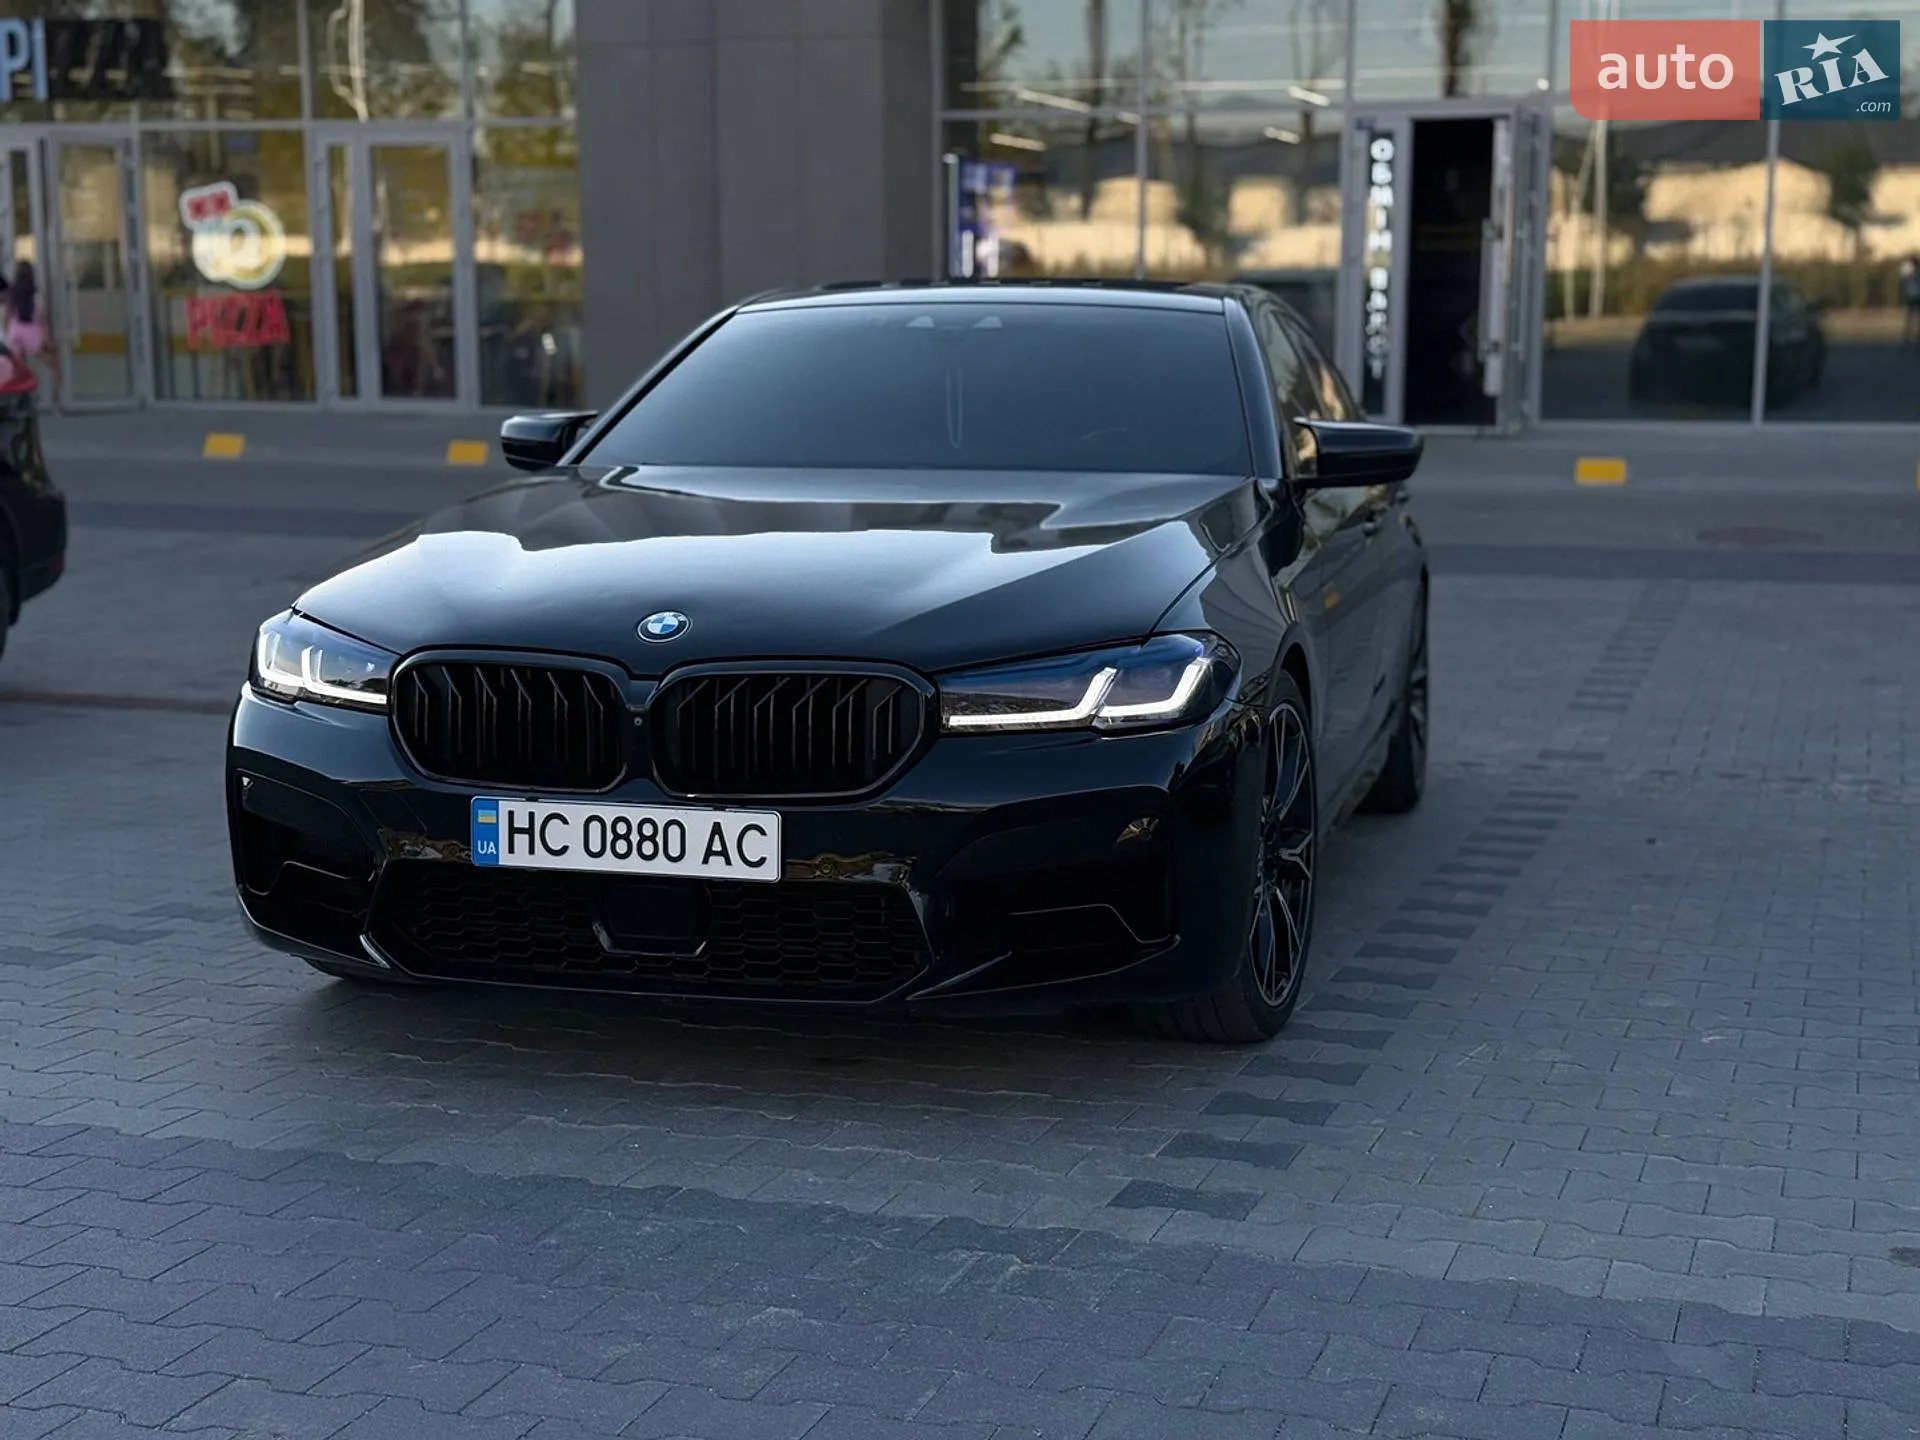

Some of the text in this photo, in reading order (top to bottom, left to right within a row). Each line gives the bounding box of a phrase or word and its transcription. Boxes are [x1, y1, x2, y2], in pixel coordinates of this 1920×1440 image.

[187, 289, 290, 348] PIZZA
[477, 840, 497, 855] UA
[507, 810, 768, 869] HC 0880 AC
